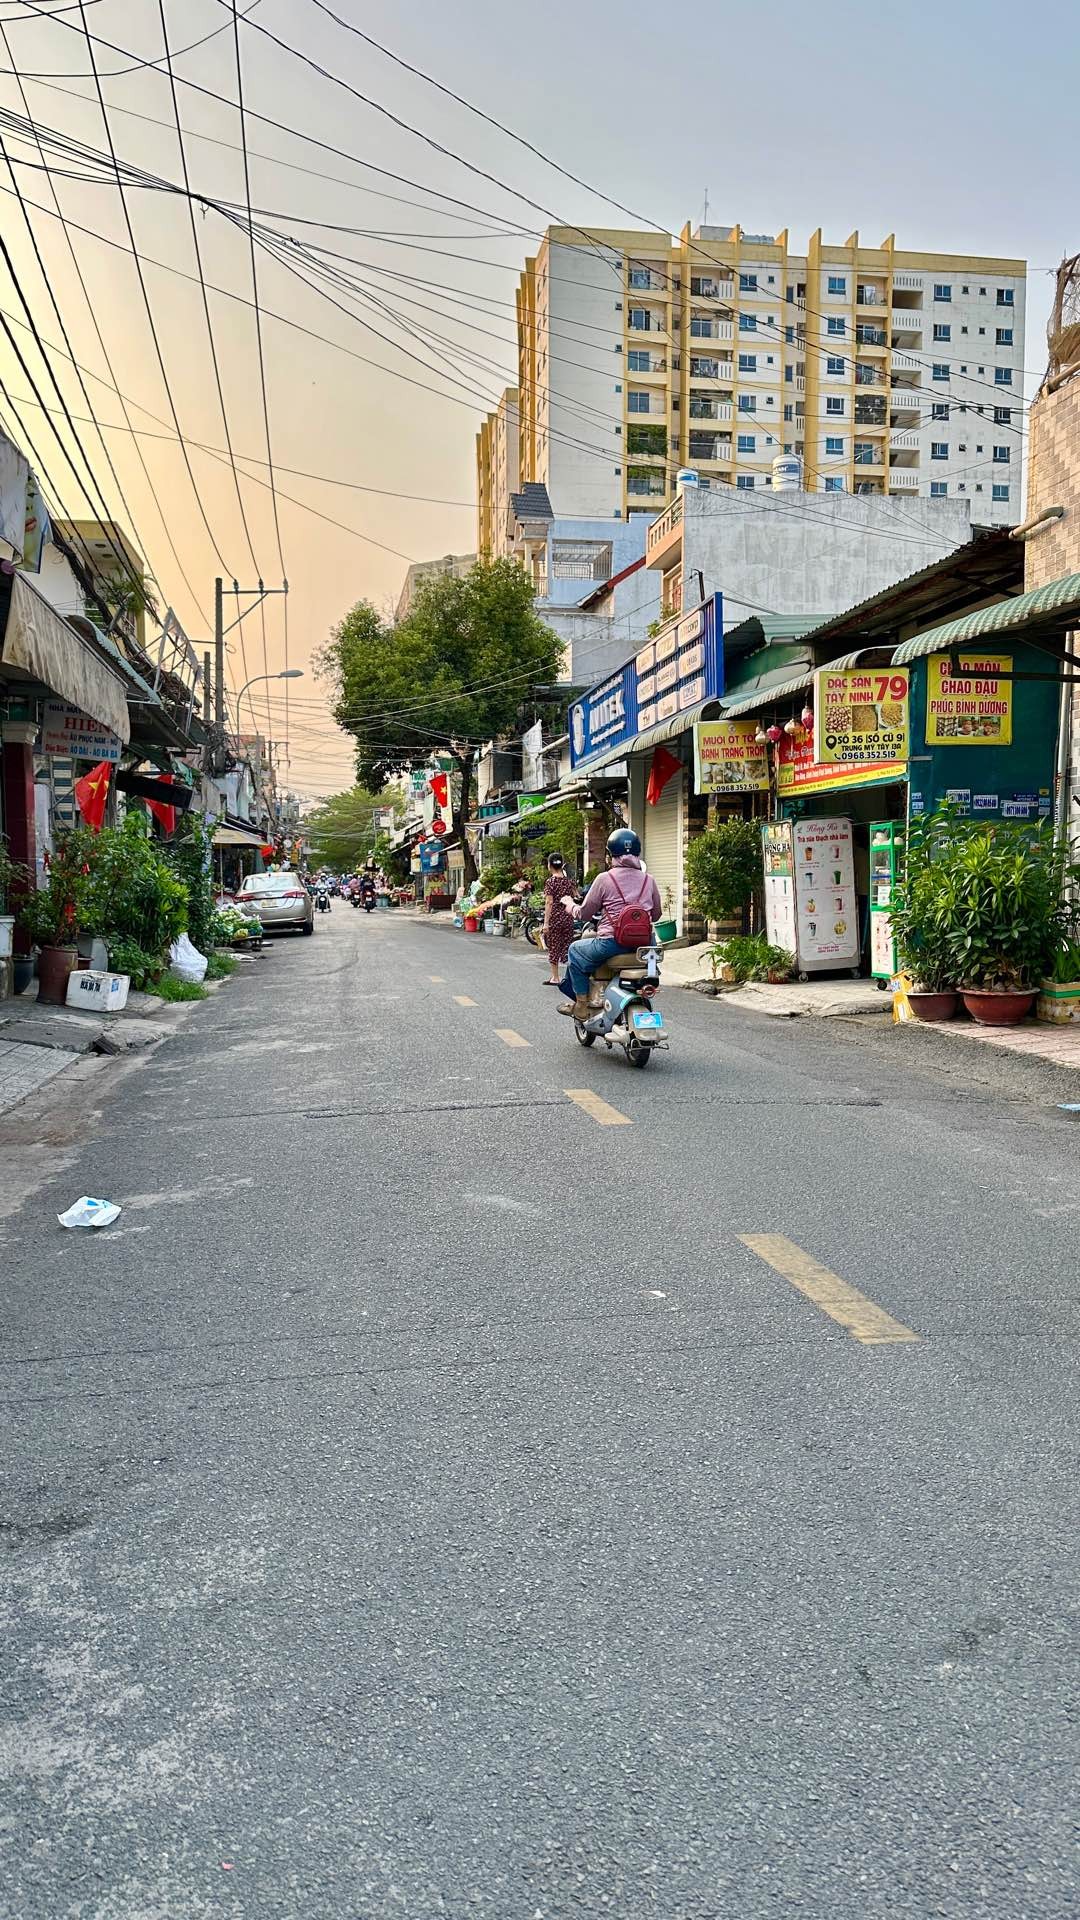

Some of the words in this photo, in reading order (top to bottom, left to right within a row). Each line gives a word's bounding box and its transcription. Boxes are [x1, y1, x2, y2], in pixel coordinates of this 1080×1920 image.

[875, 676, 908, 701] 79
[849, 692, 874, 702] NINH
[838, 732, 849, 744] SỐ
[852, 735, 863, 744] 36
[841, 744, 862, 752] TRUNG
